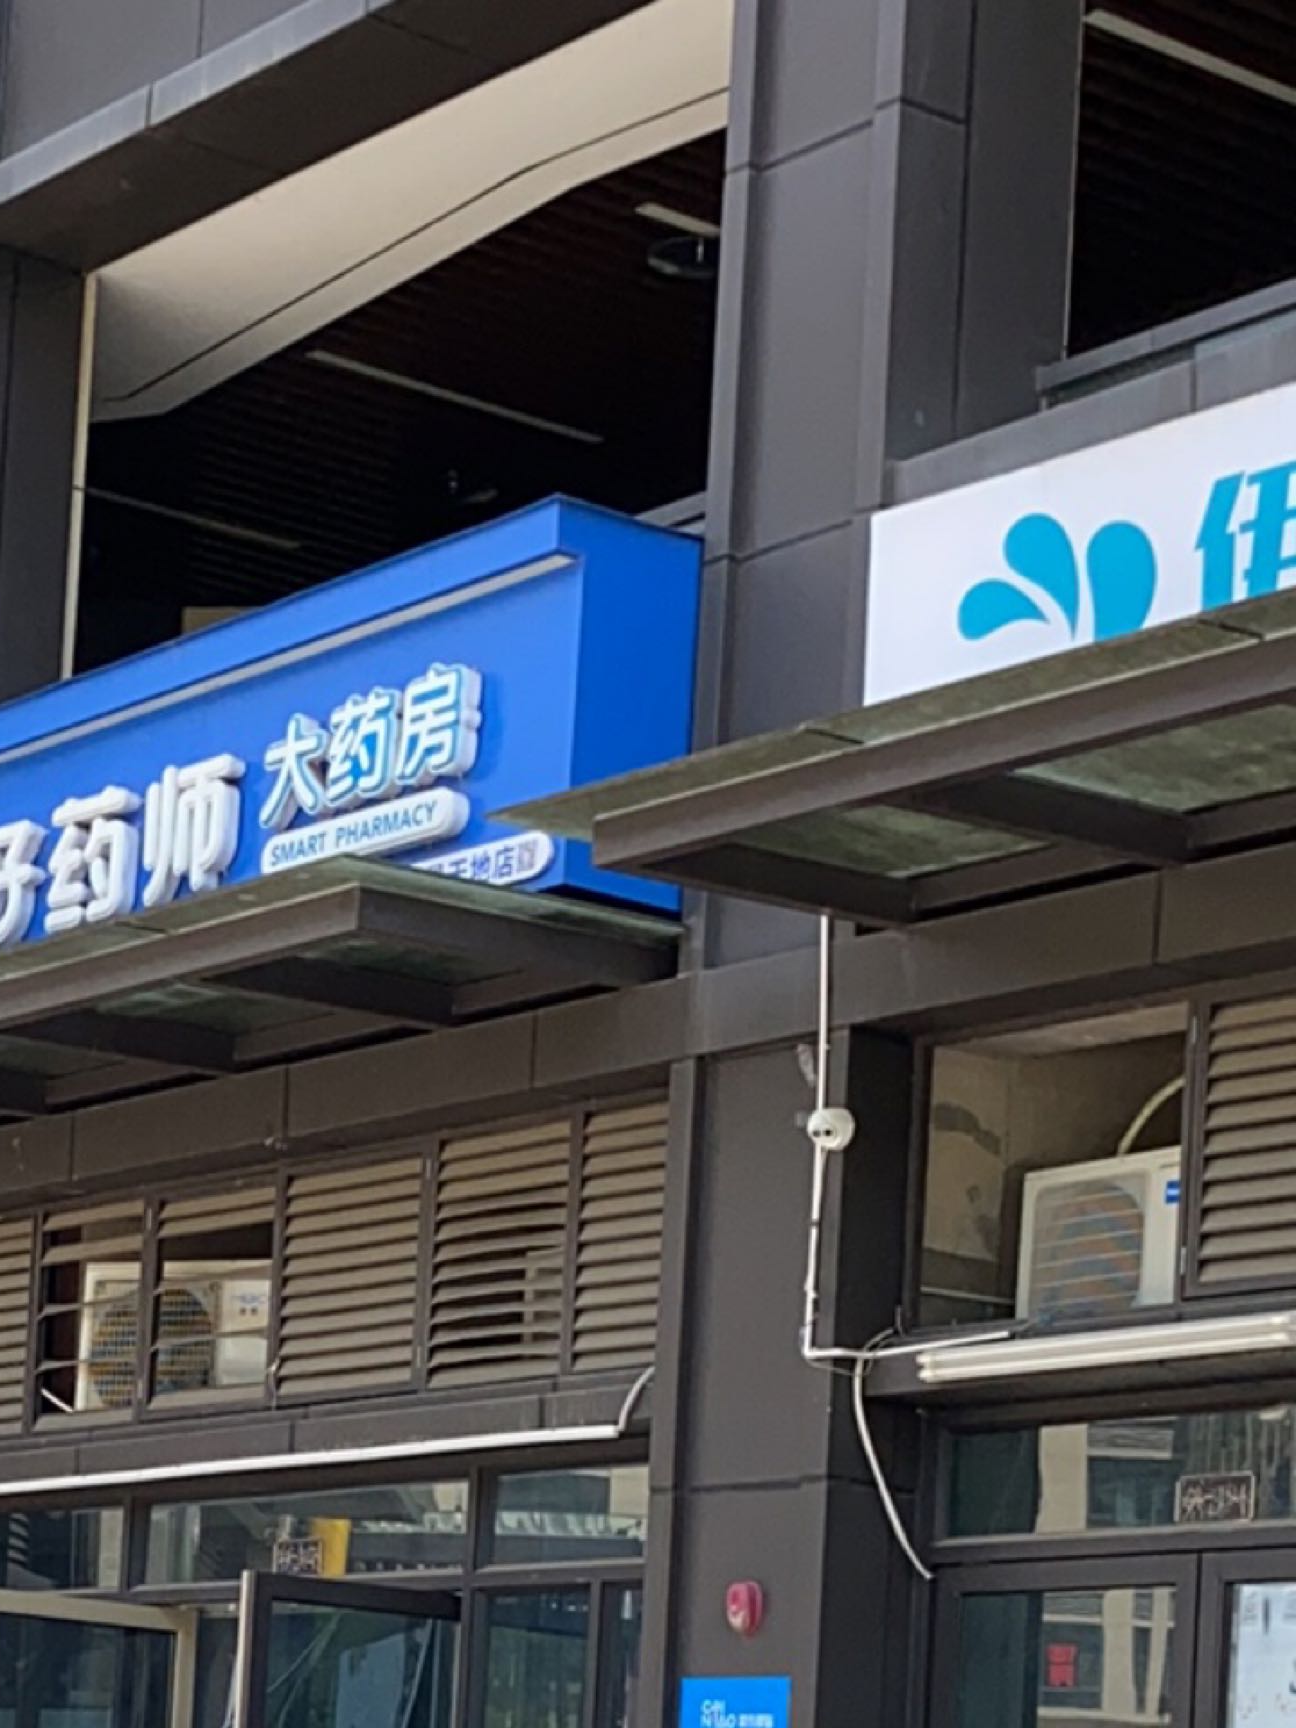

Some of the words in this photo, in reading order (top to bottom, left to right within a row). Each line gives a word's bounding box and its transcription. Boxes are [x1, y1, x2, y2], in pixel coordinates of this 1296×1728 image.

[260, 662, 482, 830] 大药房
[271, 830, 326, 866] SMART
[335, 801, 438, 848] PHARMACY
